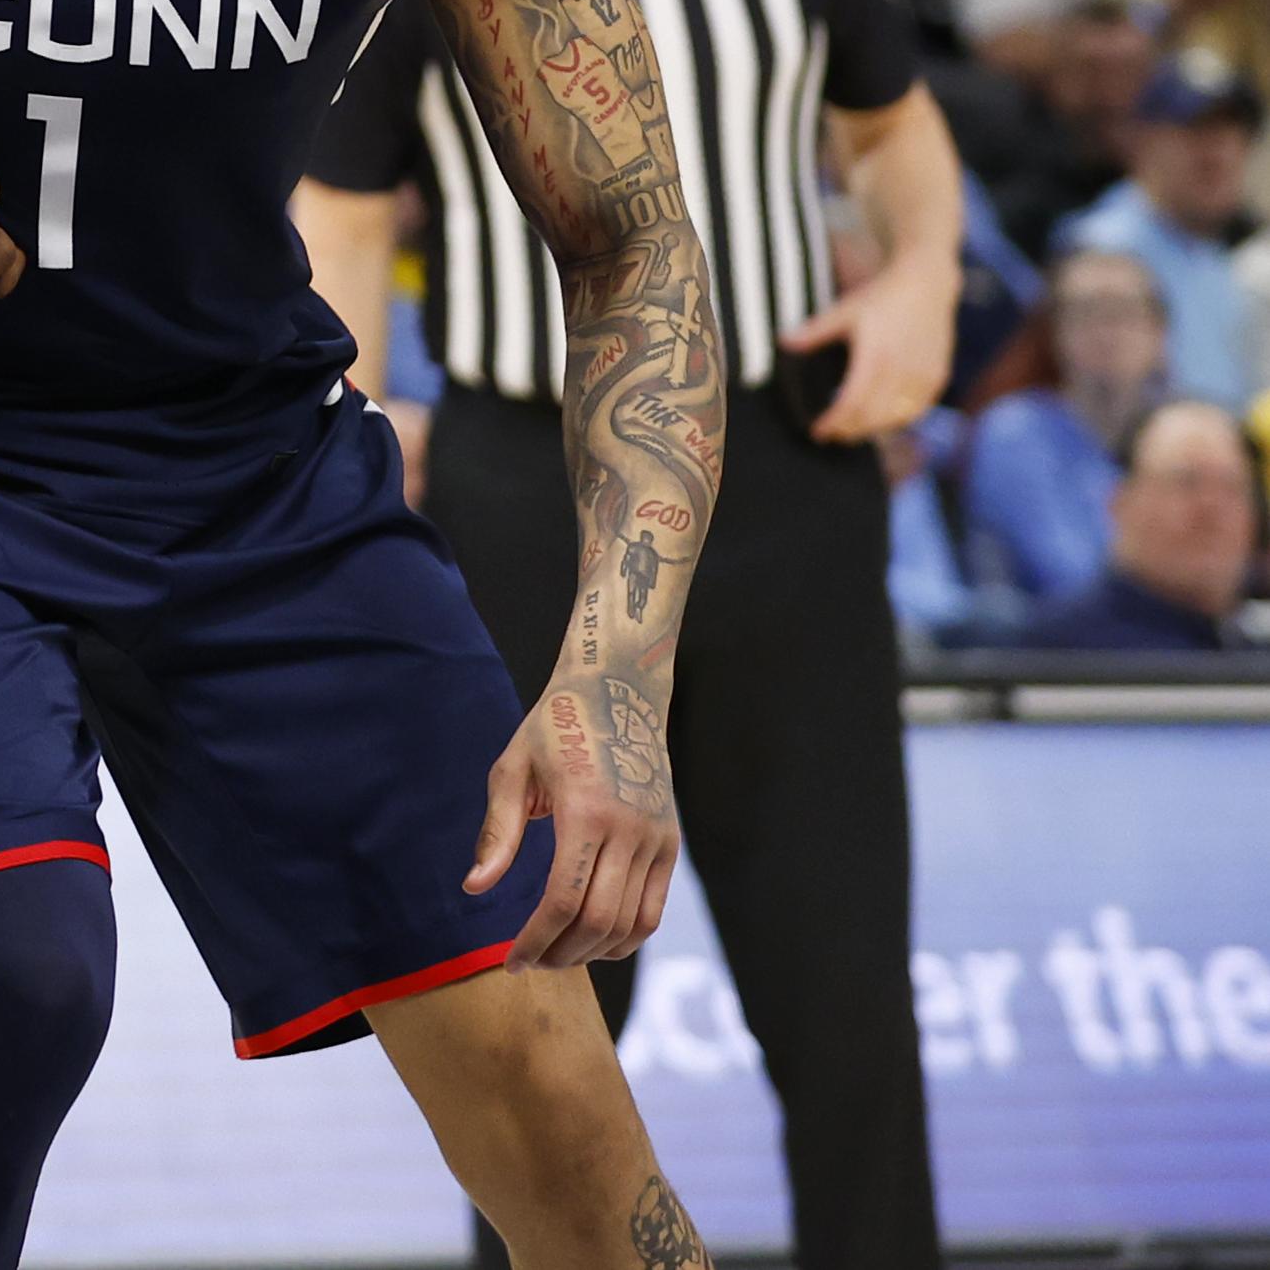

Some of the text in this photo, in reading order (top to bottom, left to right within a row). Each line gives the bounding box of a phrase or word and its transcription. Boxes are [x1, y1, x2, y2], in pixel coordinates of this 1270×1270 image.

[609, 32, 644, 73] THE
[582, 77, 610, 106] 5
[26, 93, 84, 269] 1
[636, 500, 691, 532] GOD
[1041, 906, 1270, 1076] the
